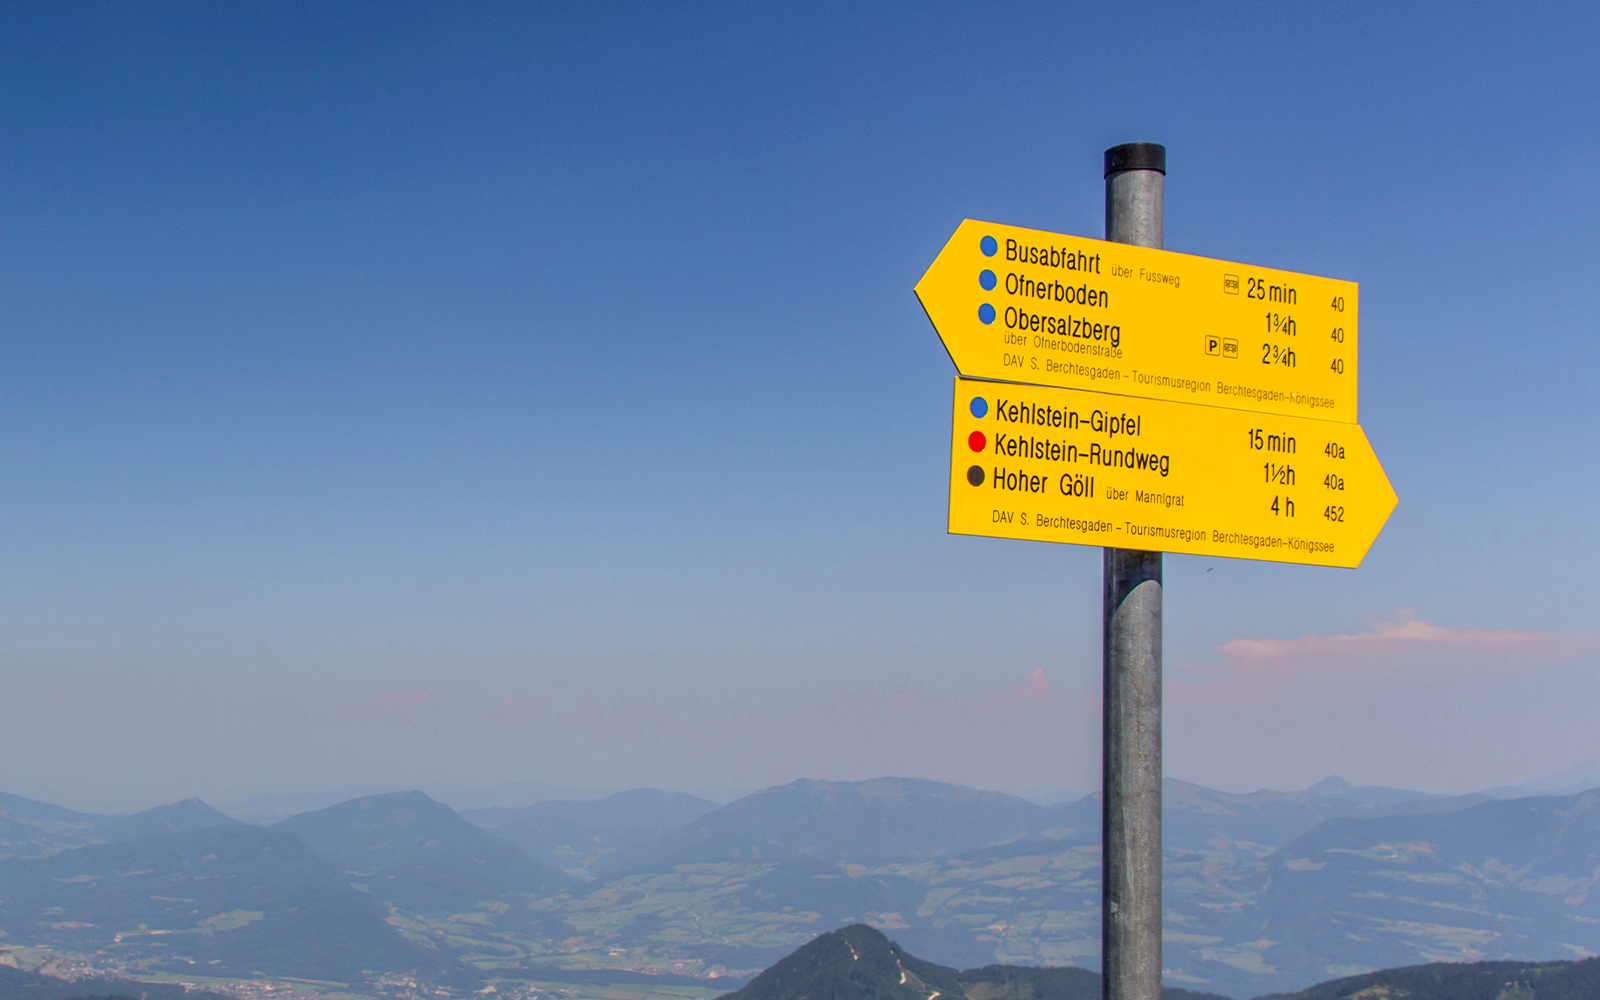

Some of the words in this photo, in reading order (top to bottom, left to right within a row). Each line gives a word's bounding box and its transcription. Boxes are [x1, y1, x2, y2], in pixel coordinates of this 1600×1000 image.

[1006, 238, 1101, 274] Busabfahrt
[1111, 263, 1133, 279] über
[1139, 268, 1180, 288] Fussweg
[1005, 272, 1108, 308] Ofnerboden
[1247, 277, 1266, 300] 25
[1269, 283, 1297, 305] min
[1331, 296, 1345, 312] 40
[1004, 306, 1121, 347] Obersalzberg
[1331, 327, 1345, 344] 40
[1004, 331, 1027, 346] über
[1033, 335, 1123, 359] Ofnerbodenstraße
[1209, 340, 1218, 352] P
[1003, 353, 1025, 367] DAV
[1030, 357, 1040, 370] S.
[1046, 359, 1121, 380] Berchtesgaden
[1132, 370, 1211, 394] Tourismusregion
[1330, 358, 1344, 374] 40
[1248, 428, 1264, 450] 15
[1268, 432, 1296, 454] min
[1324, 442, 1346, 459] 40a
[993, 467, 1048, 494] Hoher
[1059, 473, 1094, 498] Göll
[1106, 487, 1129, 501] über
[1324, 473, 1345, 491] 40a
[1271, 495, 1280, 516] 4
[1285, 496, 1295, 518] h
[1324, 505, 1344, 523] 452
[992, 510, 1014, 524] DAV
[1020, 512, 1029, 526] S.
[1036, 514, 1113, 534] Berchtesgaden
[1125, 520, 1206, 544] Tourismusregion
